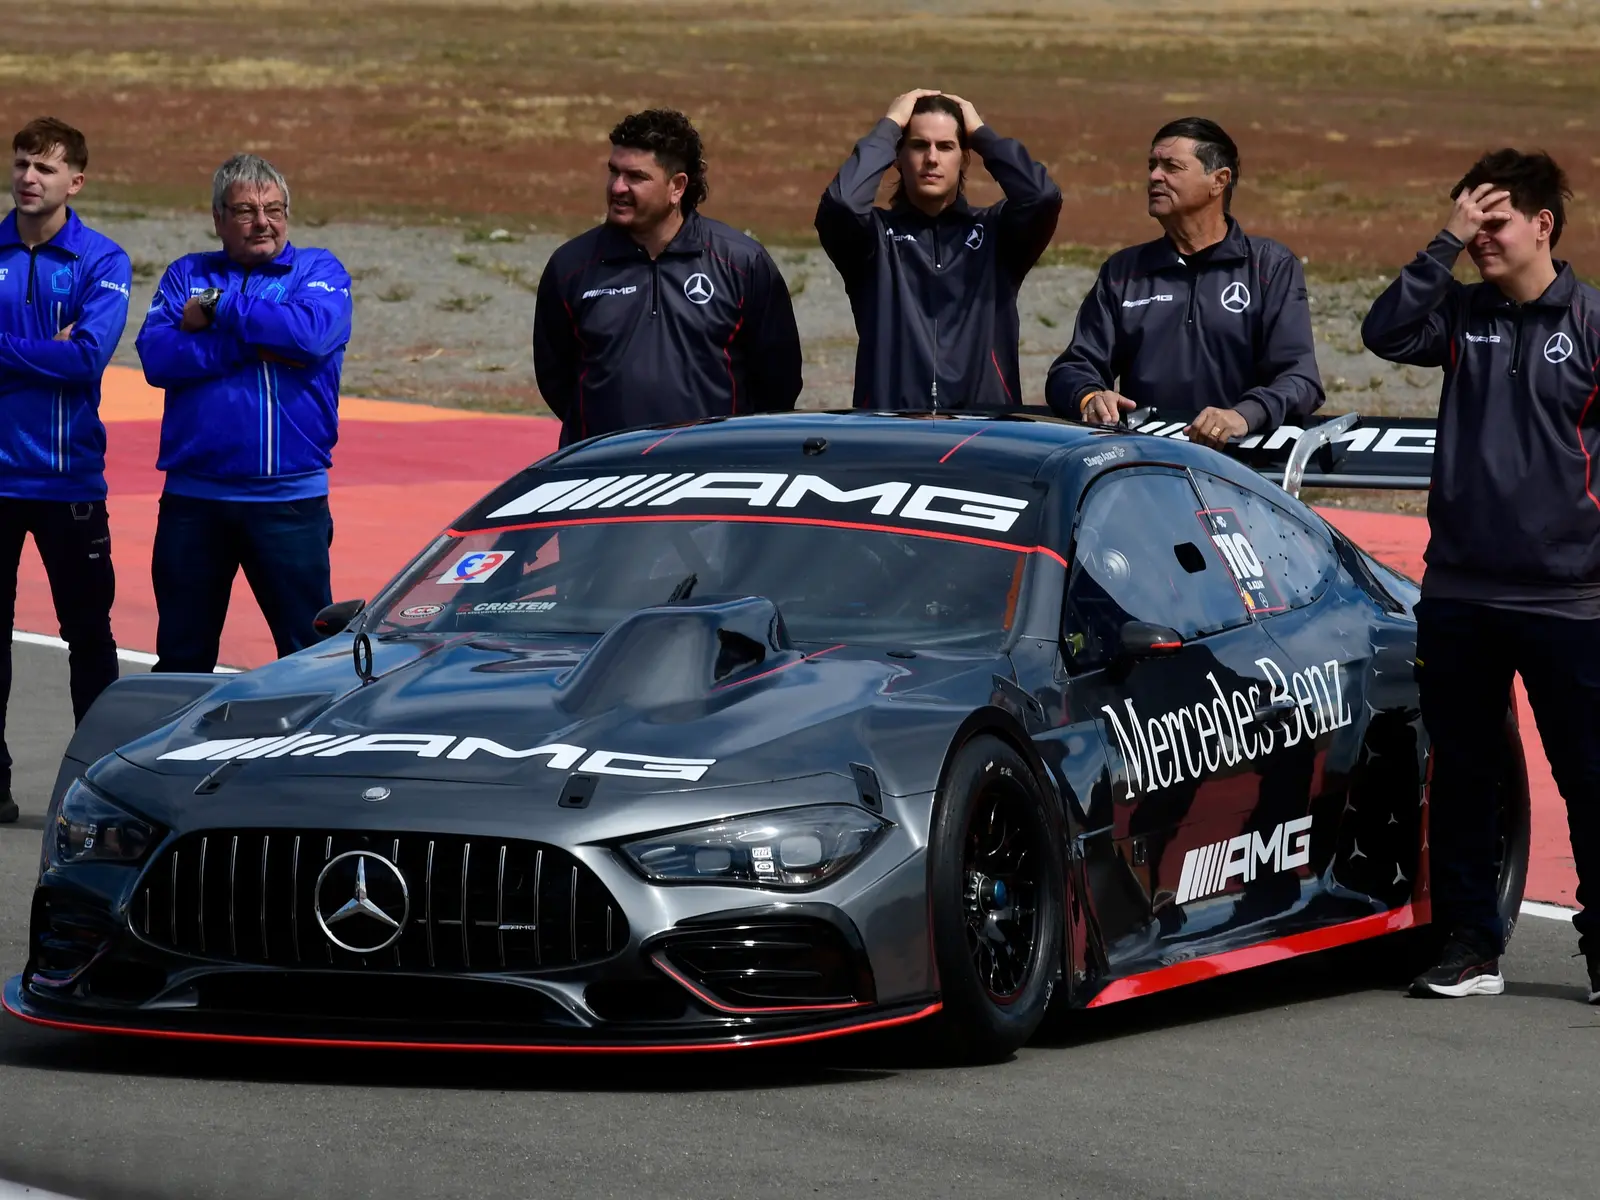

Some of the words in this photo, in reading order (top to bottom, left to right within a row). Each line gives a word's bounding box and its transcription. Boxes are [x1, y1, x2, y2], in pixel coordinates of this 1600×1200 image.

[647, 472, 1029, 533] AMG
[473, 601, 558, 612] CRISTEM
[314, 733, 717, 783] AMG
[1218, 814, 1313, 891] AMG
